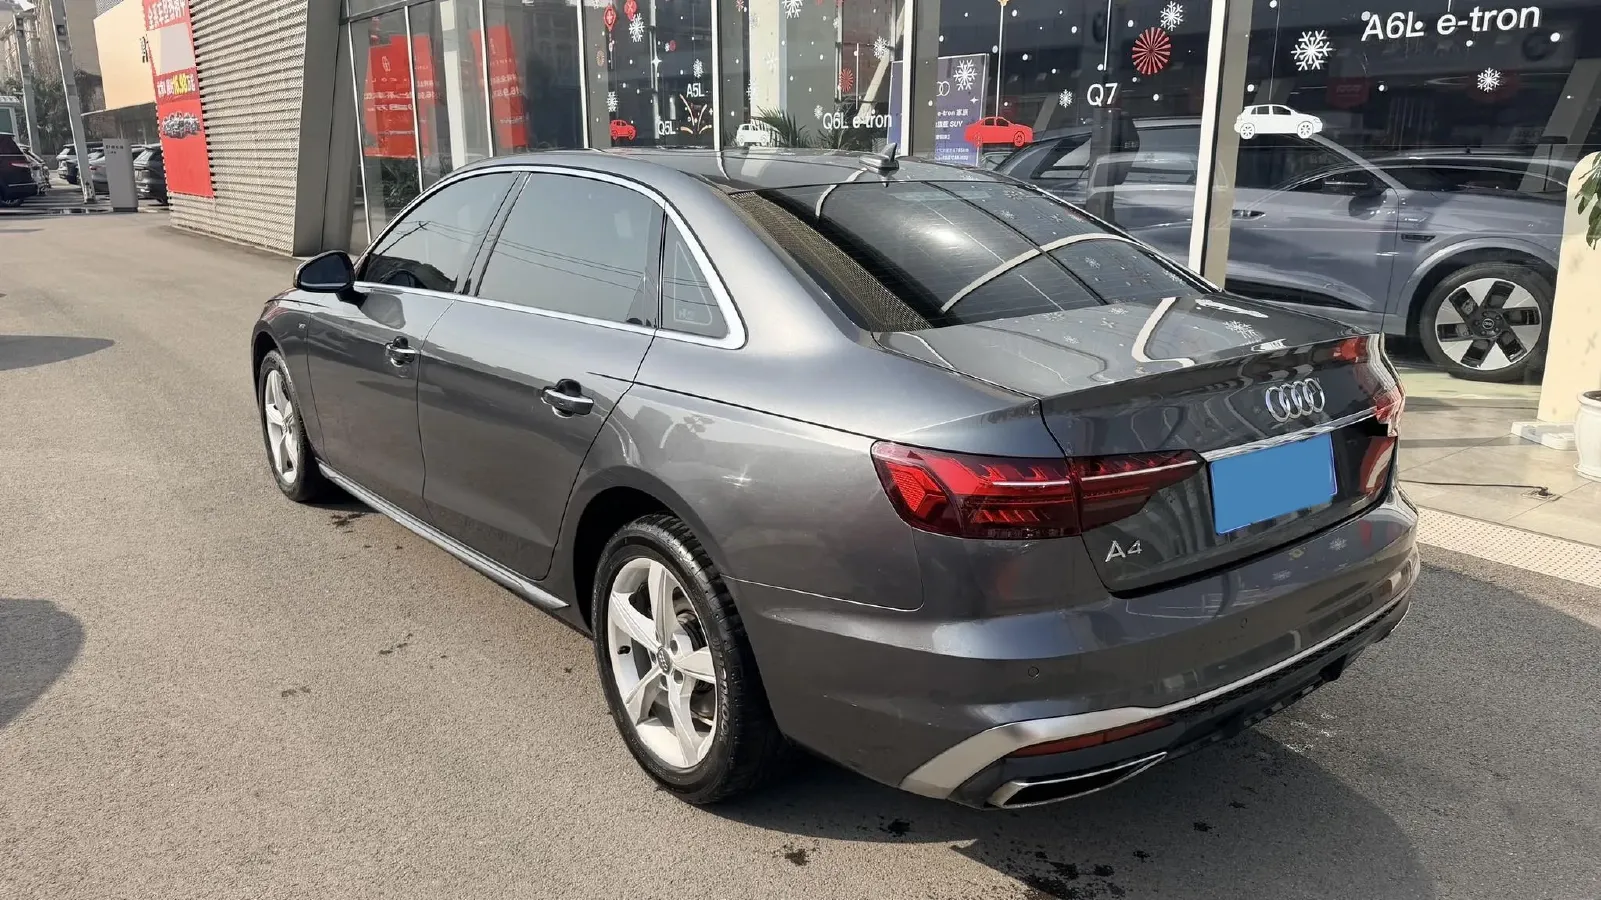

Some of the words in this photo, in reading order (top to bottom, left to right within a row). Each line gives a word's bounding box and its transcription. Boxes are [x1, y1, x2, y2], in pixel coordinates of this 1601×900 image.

[1361, 11, 1425, 42] A6L
[1437, 5, 1540, 35] e-tron
[686, 82, 705, 98] A5L
[1086, 83, 1118, 107] Q7
[657, 120, 676, 136] Q5L
[822, 112, 849, 130] Q6L
[852, 112, 892, 128] e-tron
[1104, 539, 1143, 563] A4
